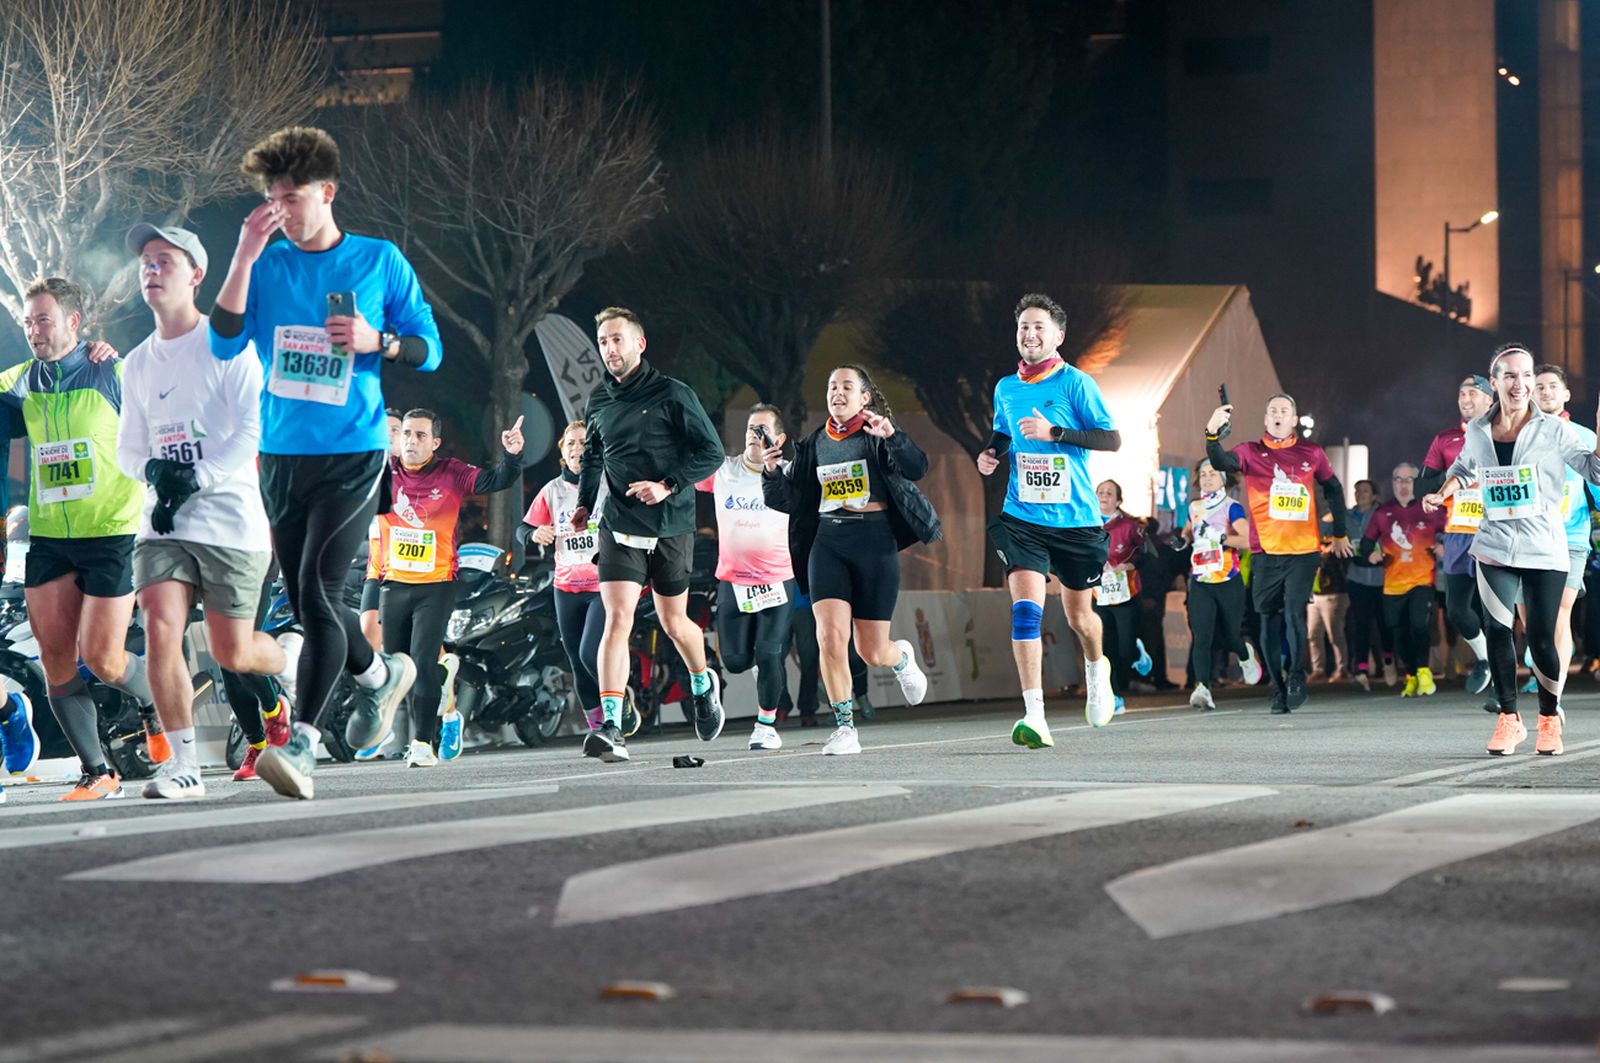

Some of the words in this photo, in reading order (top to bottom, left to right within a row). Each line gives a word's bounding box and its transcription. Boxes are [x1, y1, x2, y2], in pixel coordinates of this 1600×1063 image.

[281, 351, 343, 379] 13630
[48, 460, 80, 482] 7741
[1026, 471, 1061, 487] 6562
[1489, 484, 1529, 502] 13131
[1278, 496, 1303, 508] 3706
[1460, 502, 1484, 514] 3705
[398, 543, 425, 558] 2707
[565, 535, 594, 551] 1838
